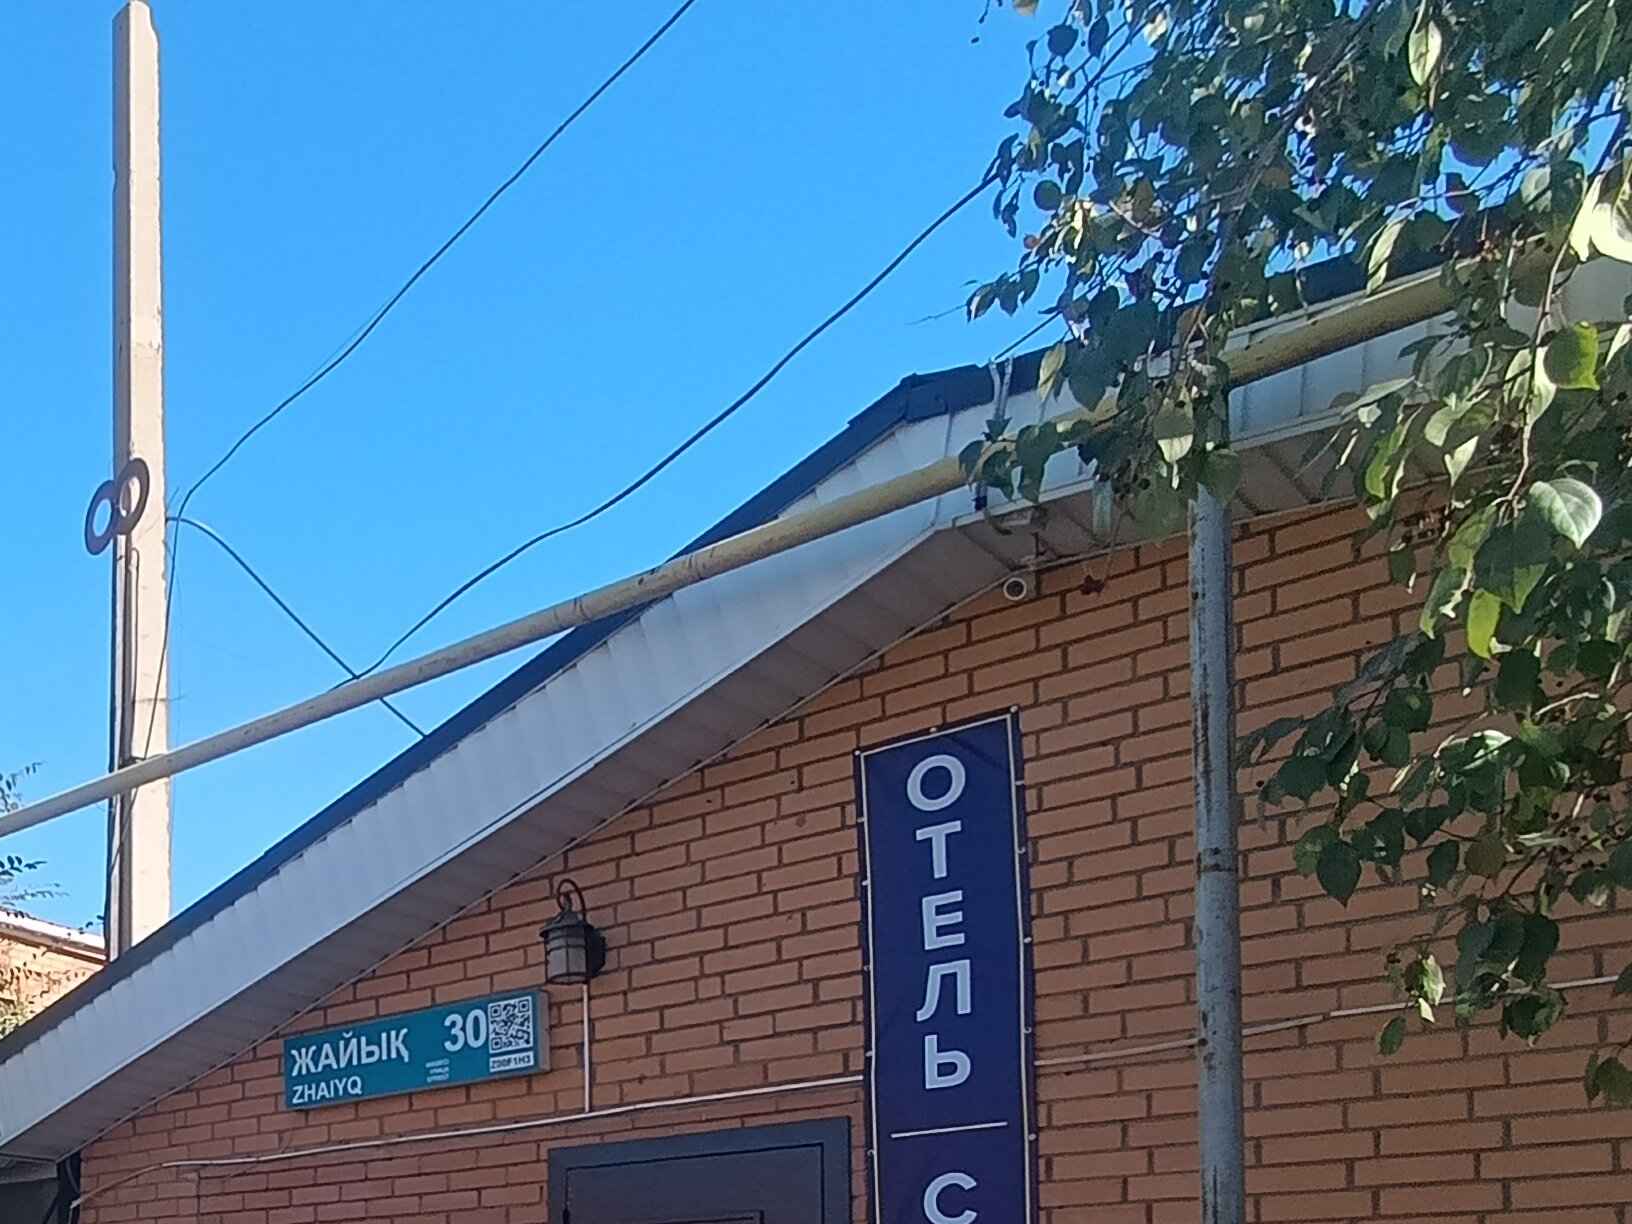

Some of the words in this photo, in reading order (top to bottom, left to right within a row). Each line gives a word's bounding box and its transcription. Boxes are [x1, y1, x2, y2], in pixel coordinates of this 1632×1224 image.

[906, 753, 972, 1090] ОТЕЛЬ
[290, 1028, 409, 1078] ЖАЙЫҚ
[443, 1008, 488, 1053] 30
[291, 1076, 363, 1105] ZHAIYQ
